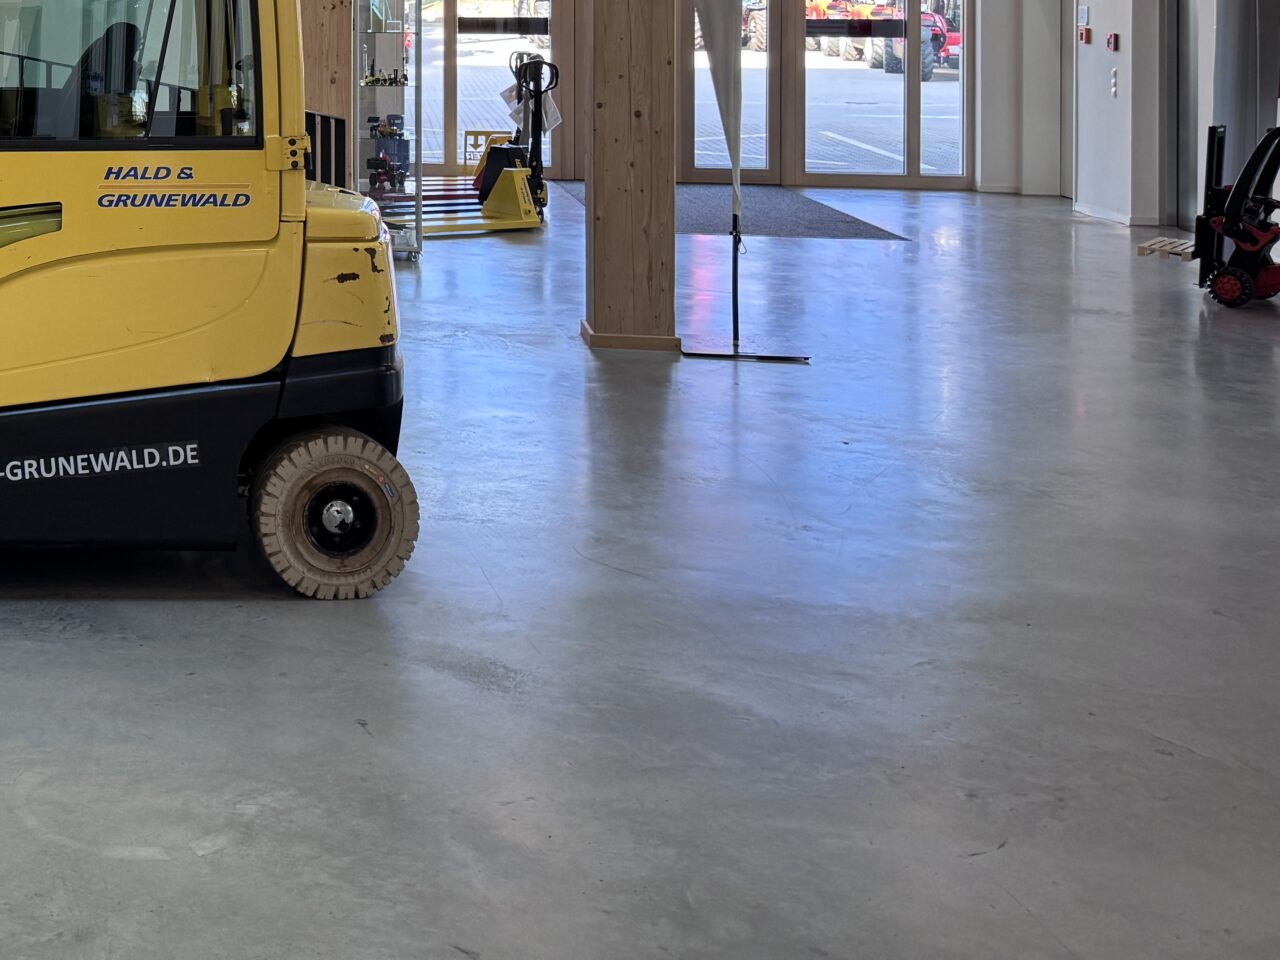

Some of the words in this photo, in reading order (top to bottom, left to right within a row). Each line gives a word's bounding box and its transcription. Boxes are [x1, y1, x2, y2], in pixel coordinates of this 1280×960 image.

[103, 166, 172, 181] HALD
[176, 166, 195, 181] &
[97, 193, 251, 208] GRUNEWALD
